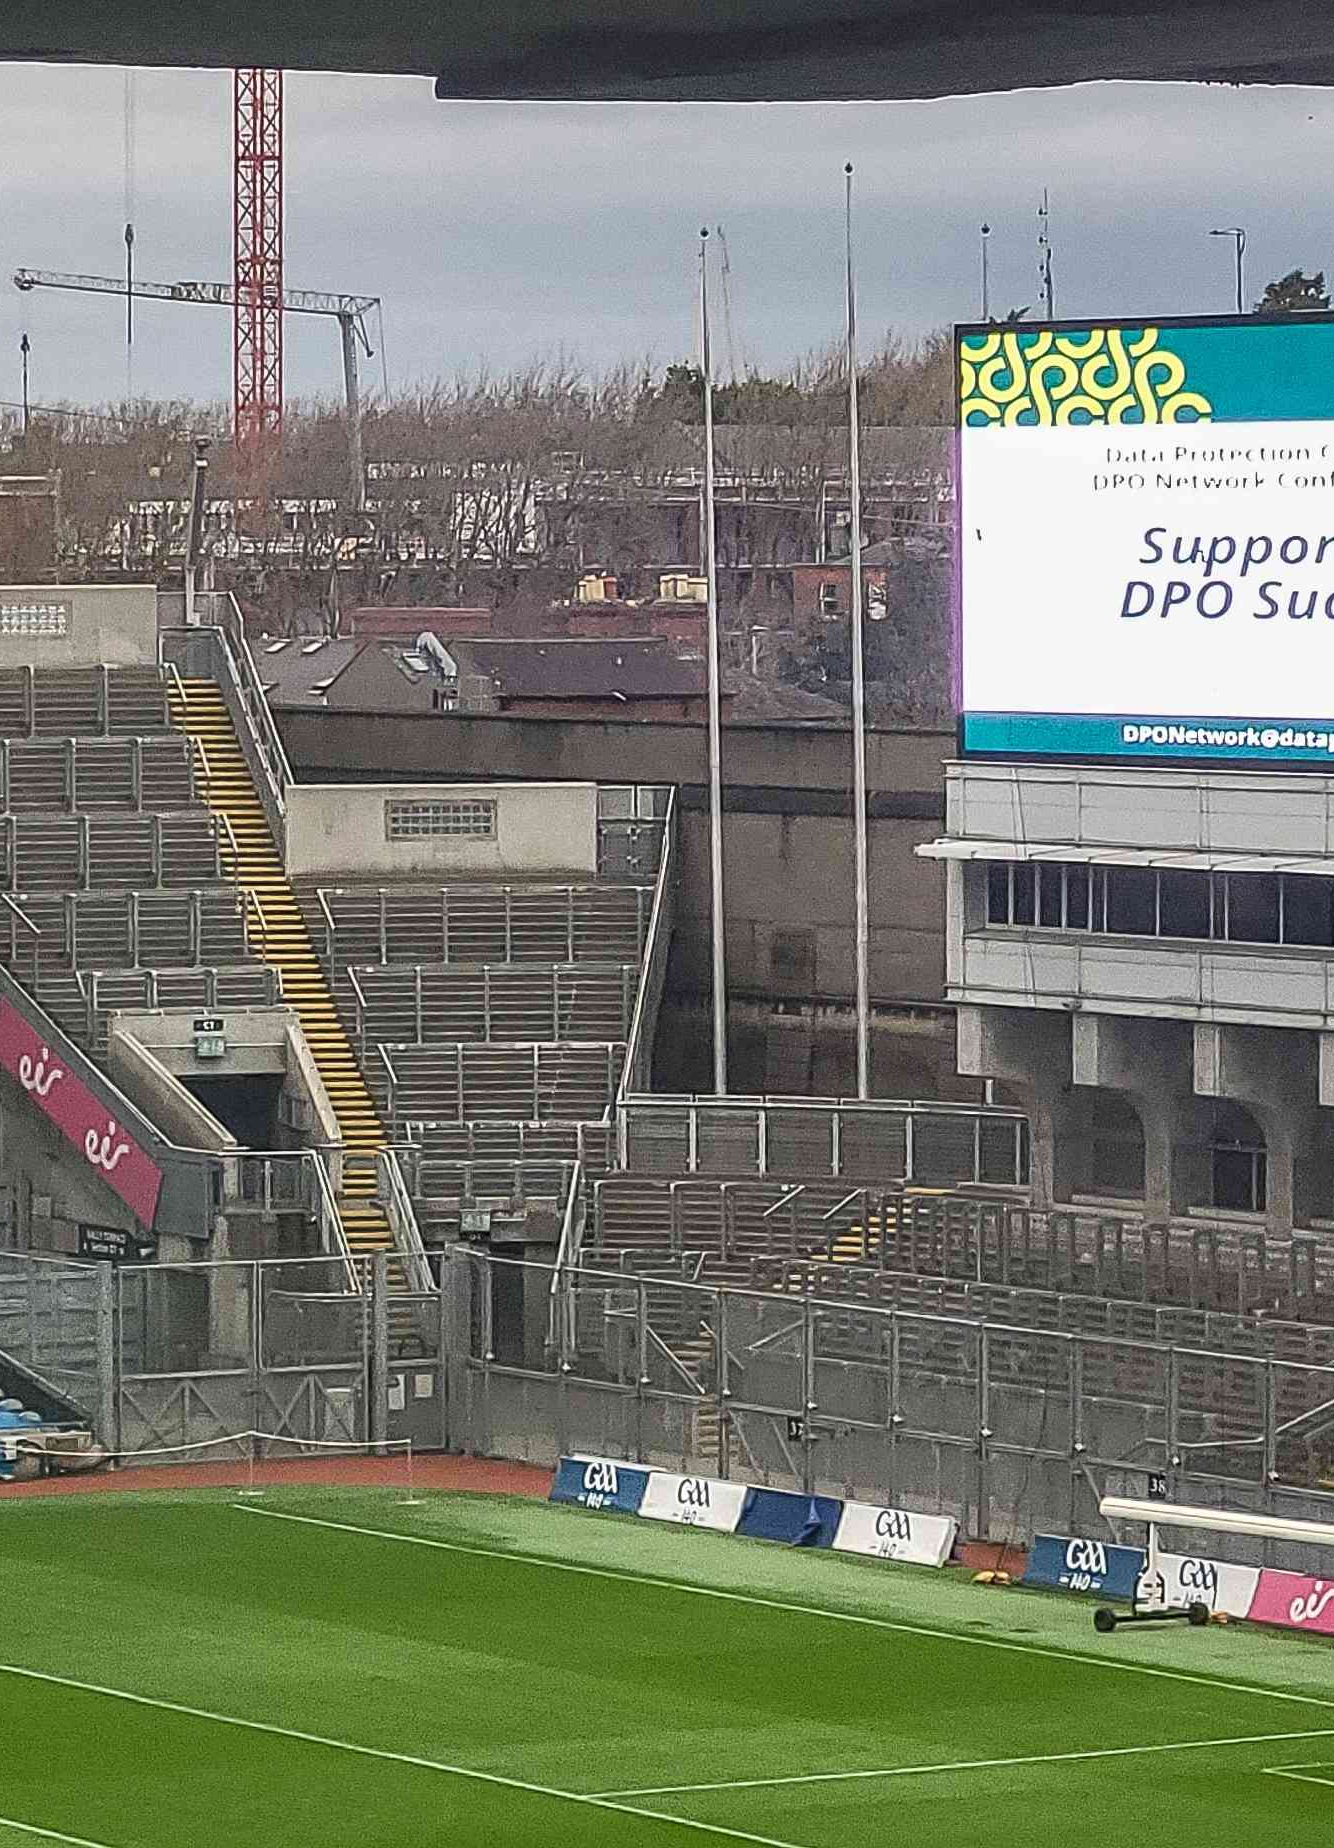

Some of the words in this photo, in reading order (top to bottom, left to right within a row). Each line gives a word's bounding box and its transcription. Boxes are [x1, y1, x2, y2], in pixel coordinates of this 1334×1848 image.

[1106, 447, 1164, 463] Data
[1175, 446, 1310, 463] Protection
[1093, 473, 1145, 491] DPO
[1156, 471, 1265, 489] Network
[1120, 581, 1234, 619] DPO
[19, 1047, 64, 1096] eir
[85, 1120, 130, 1170] eir
